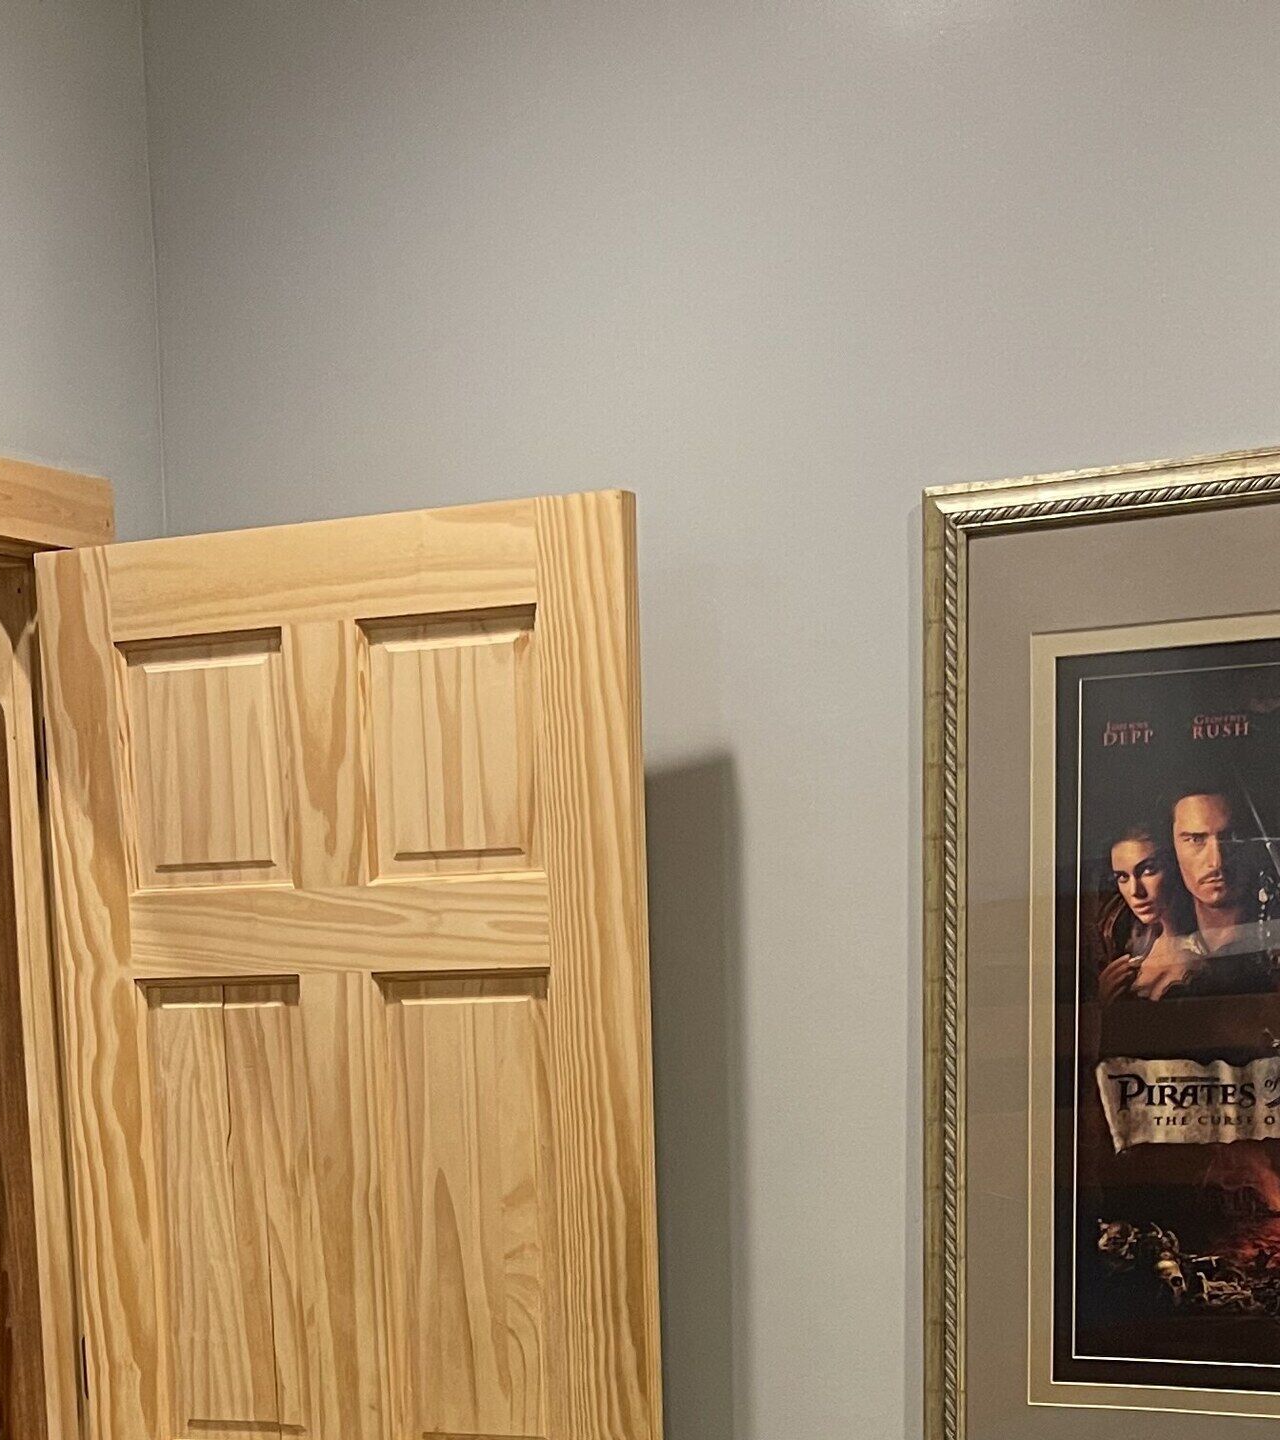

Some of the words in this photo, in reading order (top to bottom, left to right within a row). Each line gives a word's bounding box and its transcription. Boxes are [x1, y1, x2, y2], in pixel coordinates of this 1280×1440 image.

[1103, 729, 1154, 747] DEPP
[1193, 721, 1249, 740] RUSH
[1108, 1073, 1257, 1113] PIRATES
[1153, 1115, 1188, 1126] THE
[1197, 1115, 1254, 1126] CURSE
